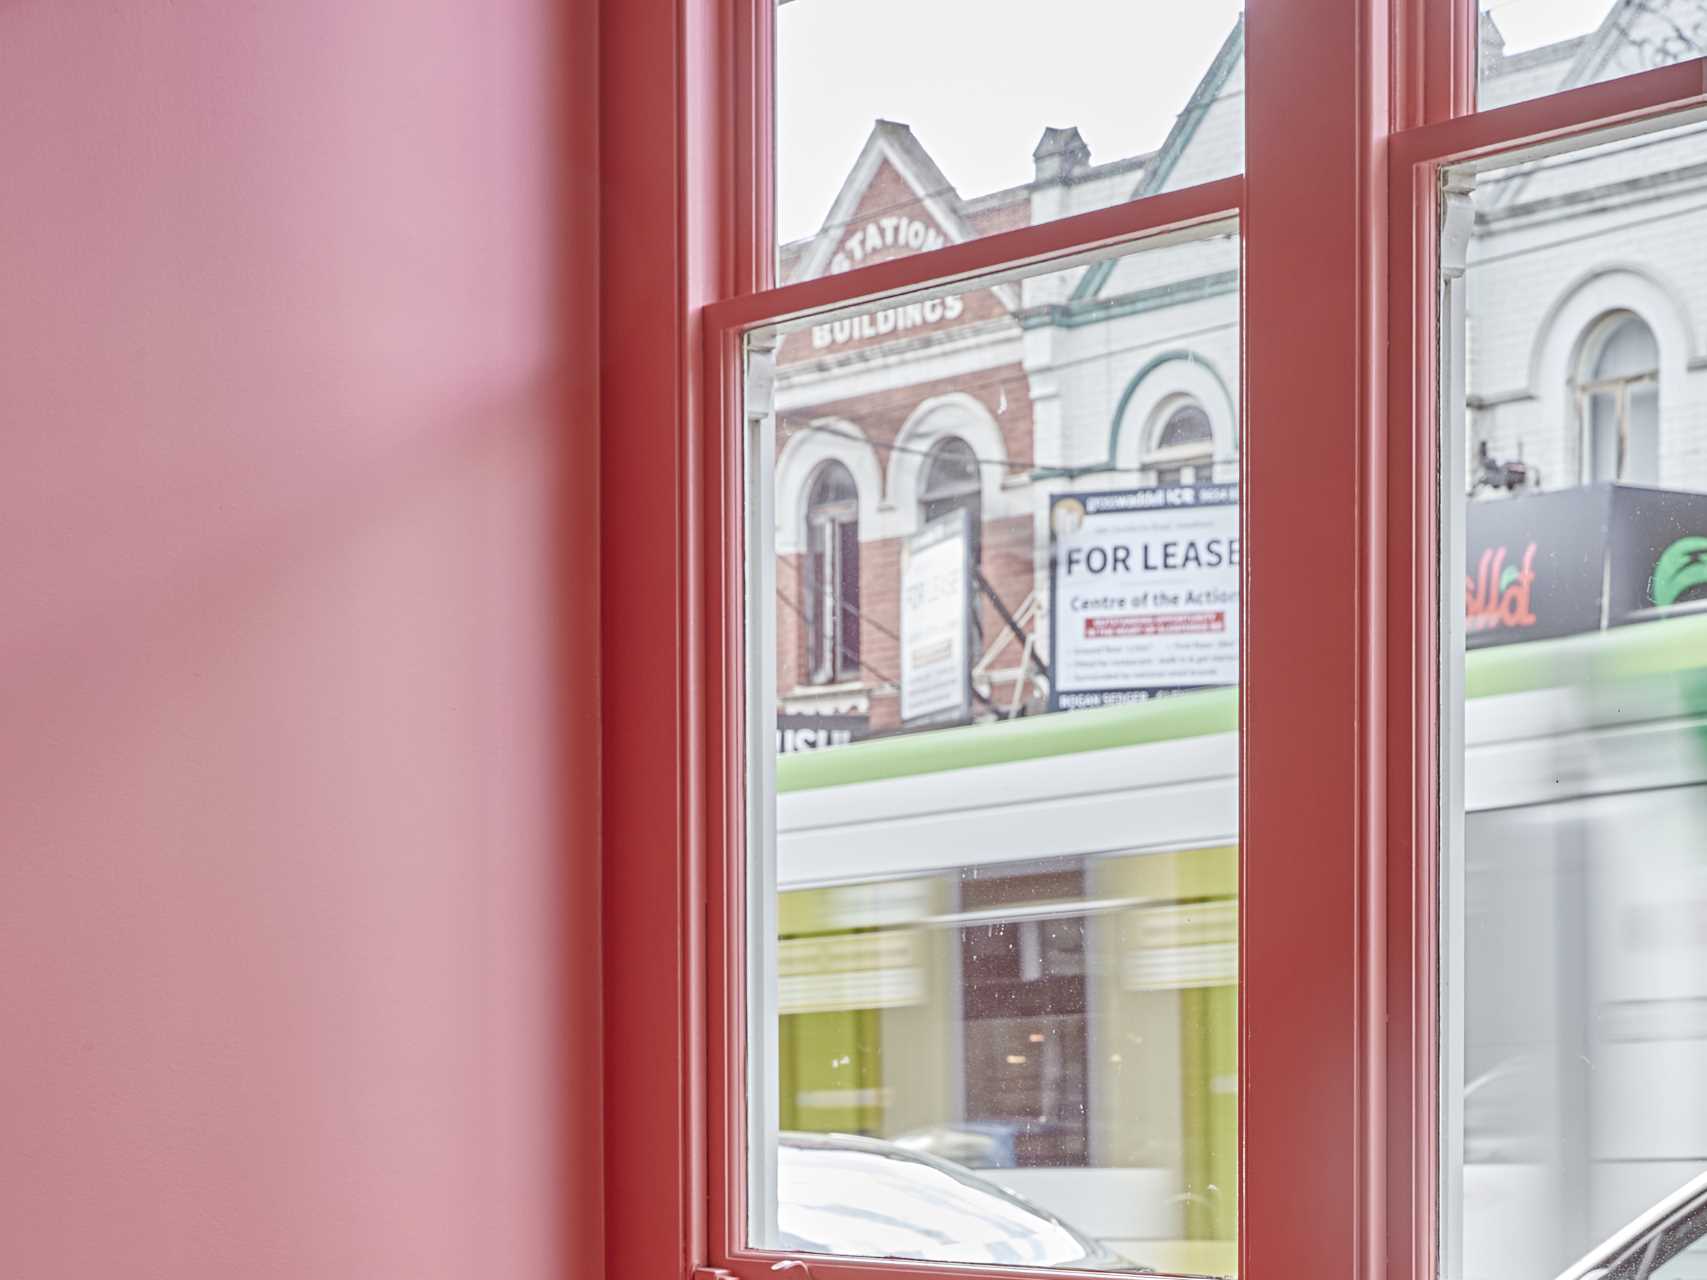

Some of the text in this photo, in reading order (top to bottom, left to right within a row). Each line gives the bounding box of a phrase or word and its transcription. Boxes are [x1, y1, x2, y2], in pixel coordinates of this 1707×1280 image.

[812, 296, 964, 348] BUILDINGS
[1067, 538, 1240, 575] FOR LEASE
[1070, 593, 1127, 611] Centre
[1131, 591, 1150, 608] of
[1153, 589, 1180, 606] the
